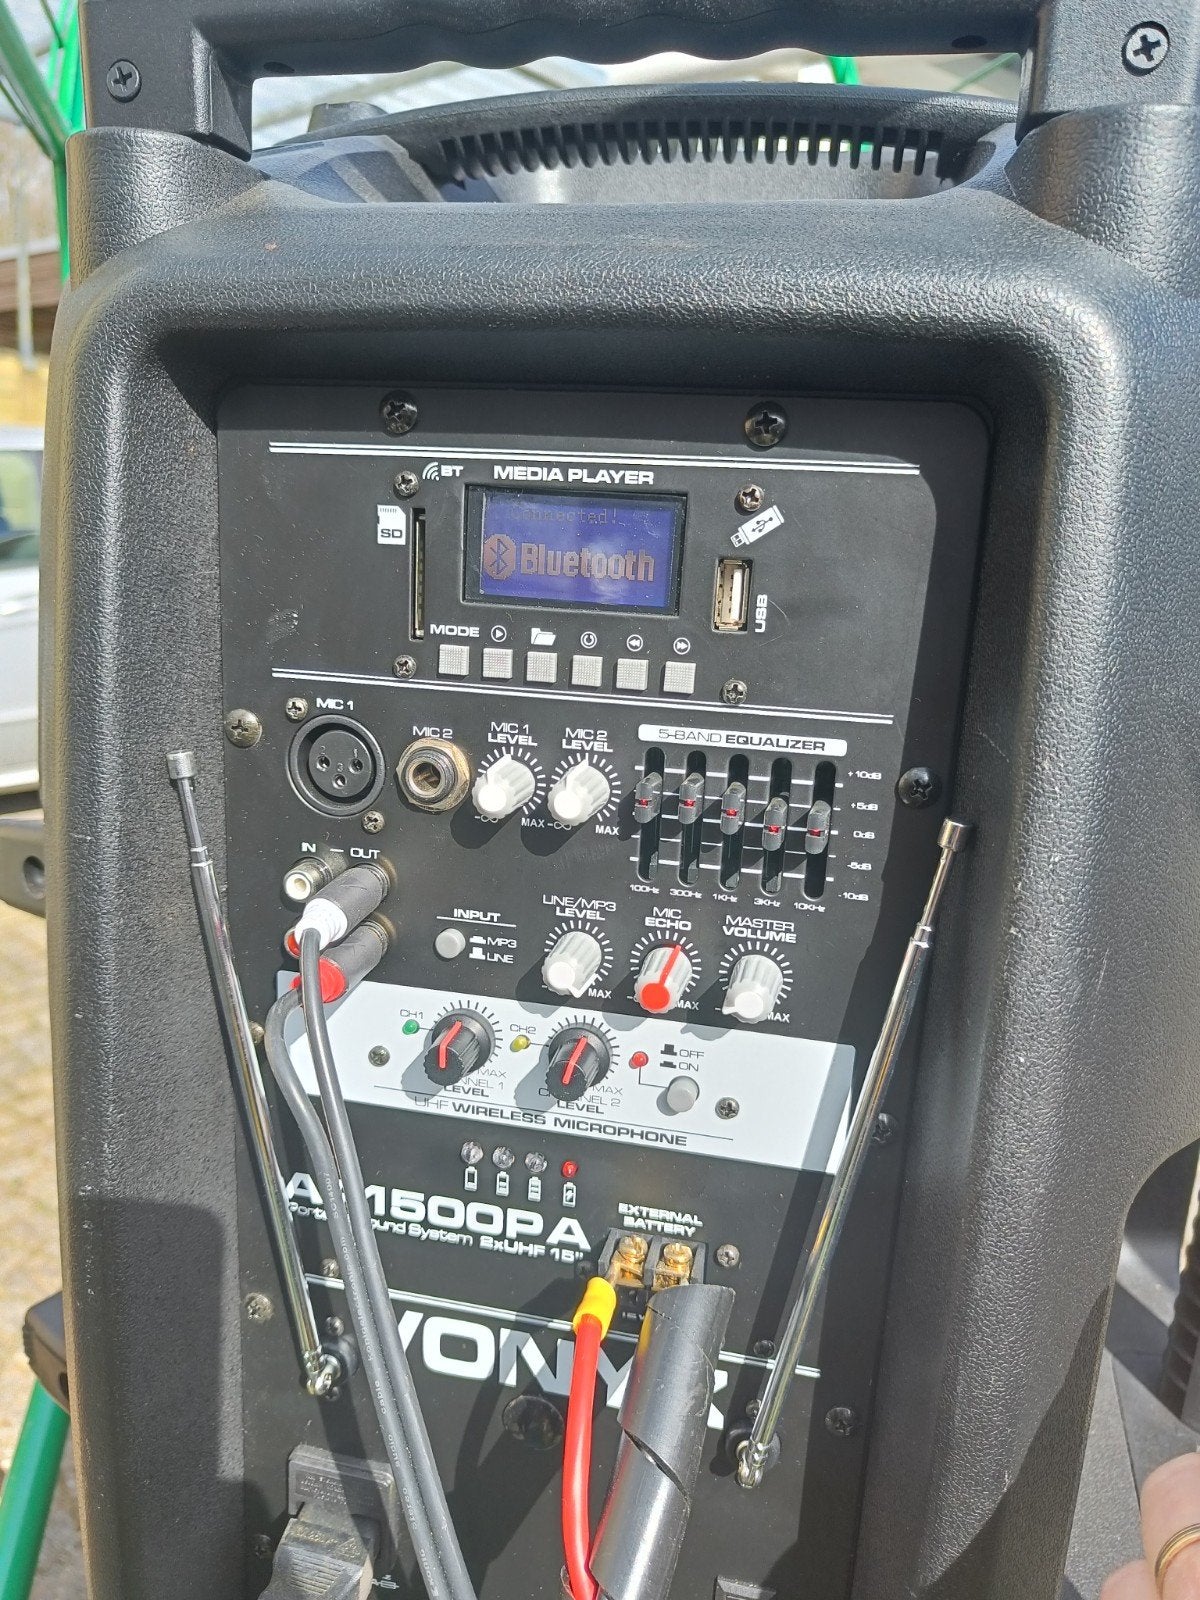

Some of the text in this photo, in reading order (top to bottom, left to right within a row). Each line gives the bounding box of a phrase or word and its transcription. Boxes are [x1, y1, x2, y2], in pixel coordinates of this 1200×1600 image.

[441, 465, 464, 477] BT
[494, 465, 654, 485] MEDIA PLAYER
[380, 528, 403, 539] SD
[520, 542, 655, 582] Bluetooth
[755, 593, 768, 633] USB
[430, 624, 480, 638] MODE
[316, 697, 354, 711] MIC 1
[412, 725, 453, 739] MIC 2
[490, 721, 529, 735] MIC 1
[565, 727, 608, 741] MIC 2
[487, 732, 538, 747] LEVEL
[562, 739, 614, 753] LEVEL
[658, 728, 826, 751] 5-BAND EQUALIZER
[850, 801, 879, 811] +5dB
[521, 817, 545, 828] MAX
[595, 824, 620, 835] MAX
[853, 830, 875, 839] 0dB
[301, 842, 381, 860] IN OUT
[847, 862, 872, 871] -5dB
[629, 884, 660, 894] 100Hz
[670, 888, 702, 899] 300Hz
[838, 892, 869, 902] -10dB
[542, 894, 617, 912] LINE/MP3
[453, 908, 502, 923] INPUT
[555, 906, 606, 921] LEVEL
[652, 906, 682, 919] MIC
[644, 916, 692, 931] ECHO
[725, 914, 795, 932] MASTER
[722, 926, 797, 944] VOLUME
[487, 937, 517, 949] MP3
[487, 952, 514, 964] LINE
[588, 988, 612, 999] MAX
[676, 999, 700, 1011] MAX
[400, 1009, 424, 1020] CH1
[766, 1011, 790, 1023] MAX
[509, 1023, 536, 1035] CH2
[679, 1048, 705, 1059] OFF
[477, 1068, 507, 1079] MAX
[678, 1061, 700, 1072] ON
[444, 1085, 490, 1098] LEVEL
[592, 1085, 623, 1096] MAX
[557, 1099, 605, 1114] LEVEL
[610, 1097, 621, 1108] 2
[415, 1096, 688, 1147] UHF WIRELESS MICROPHONE
[285, 1172, 592, 1252] A1500PA
[618, 1202, 704, 1228] EXTERNAL
[623, 1215, 697, 1238] BATTERY
[408, 1223, 473, 1247] System
[479, 1235, 546, 1258] 2xUHF
[550, 1247, 584, 1264] 15"
